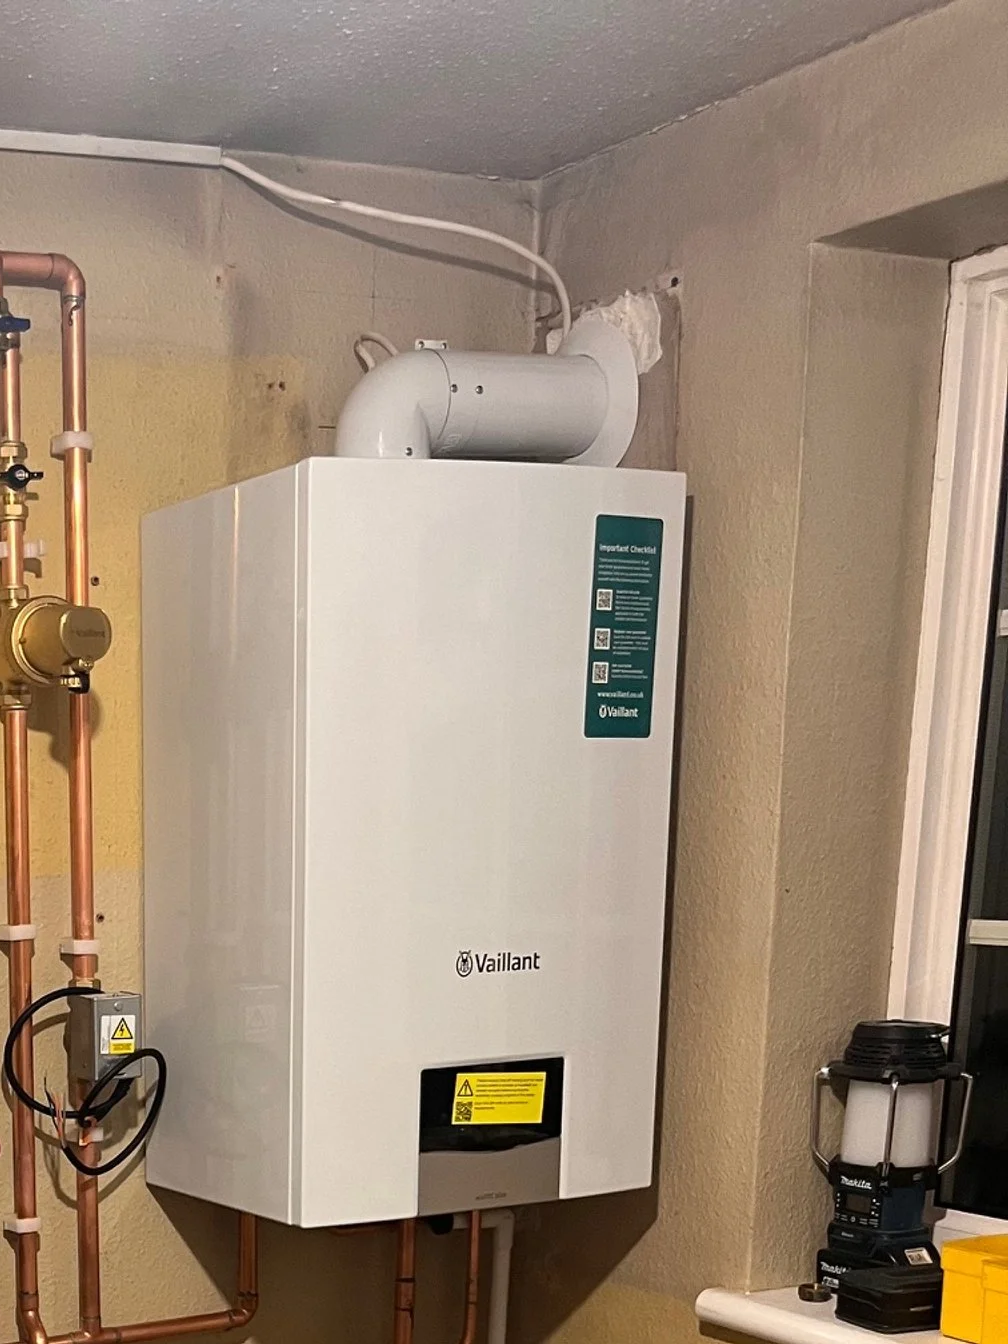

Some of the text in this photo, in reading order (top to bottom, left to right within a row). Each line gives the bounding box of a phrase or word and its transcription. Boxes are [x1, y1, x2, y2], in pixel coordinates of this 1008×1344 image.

[599, 543, 657, 555] Important Checklist
[607, 706, 639, 718] Vaillant
[474, 951, 541, 974] Vaillant
